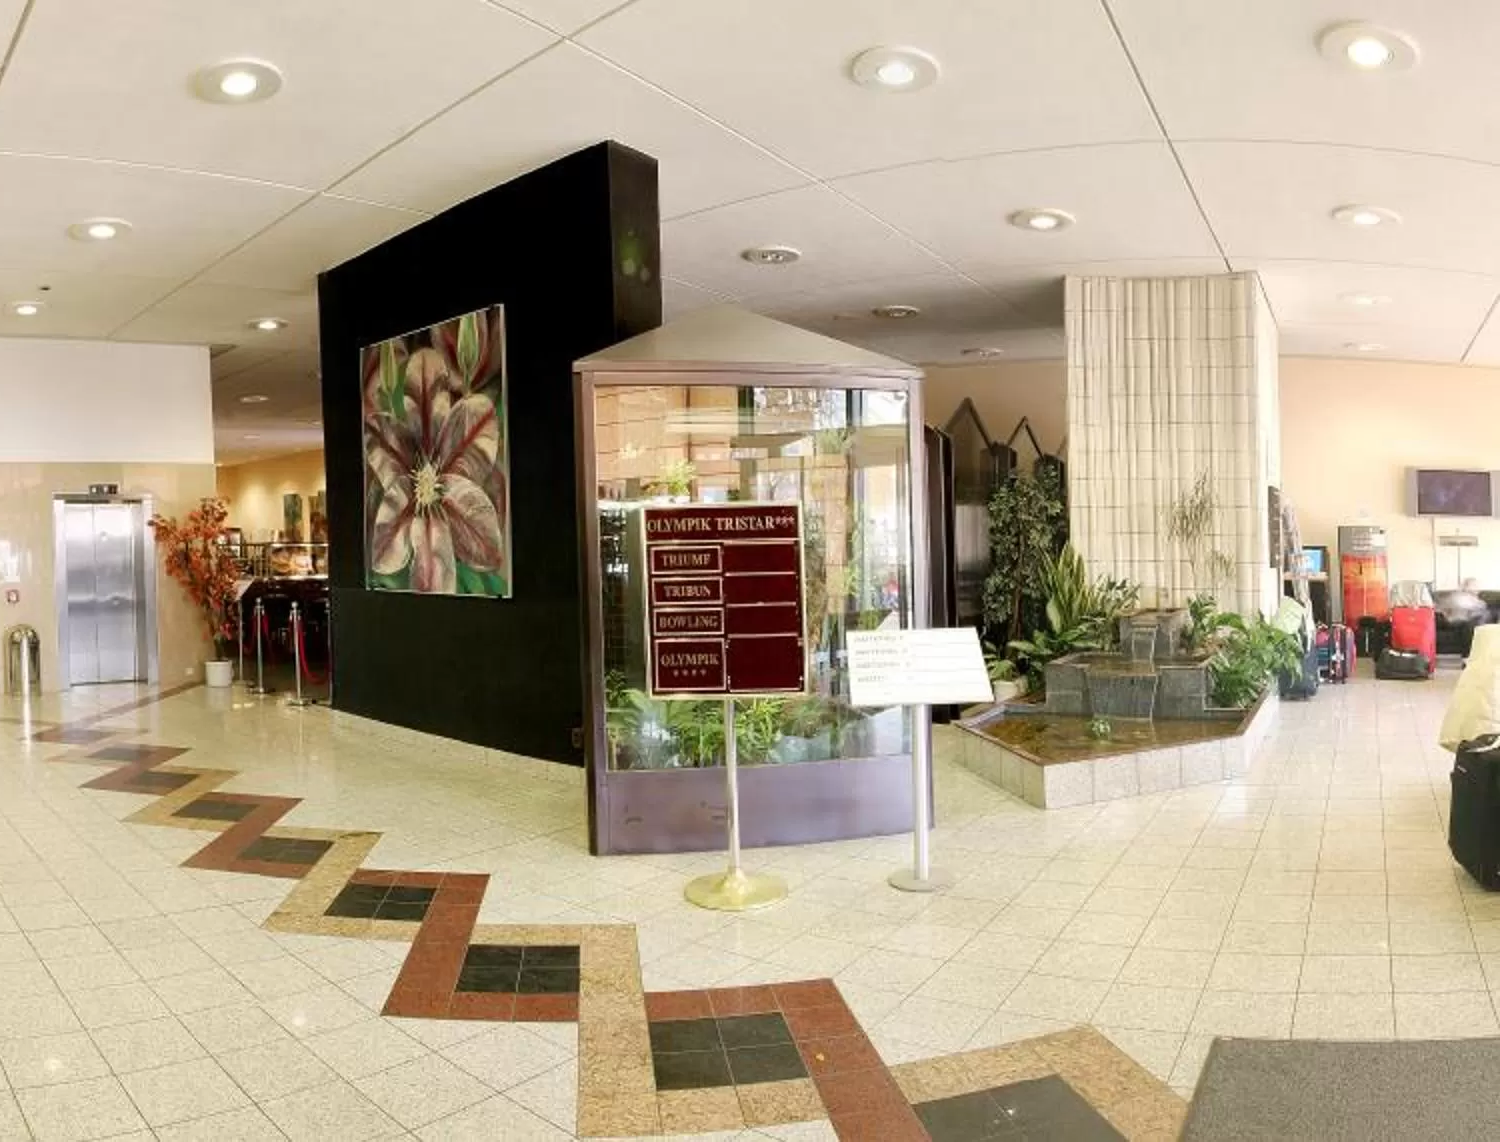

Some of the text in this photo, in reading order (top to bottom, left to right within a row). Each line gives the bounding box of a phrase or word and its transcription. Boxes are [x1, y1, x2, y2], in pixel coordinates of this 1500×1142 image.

[647, 517, 711, 533] OLYMPIK
[661, 553, 711, 567] TRIUMF
[663, 585, 711, 598] TRIBUN
[659, 615, 718, 629] BOWLING
[660, 654, 719, 667] OLYMPIK
